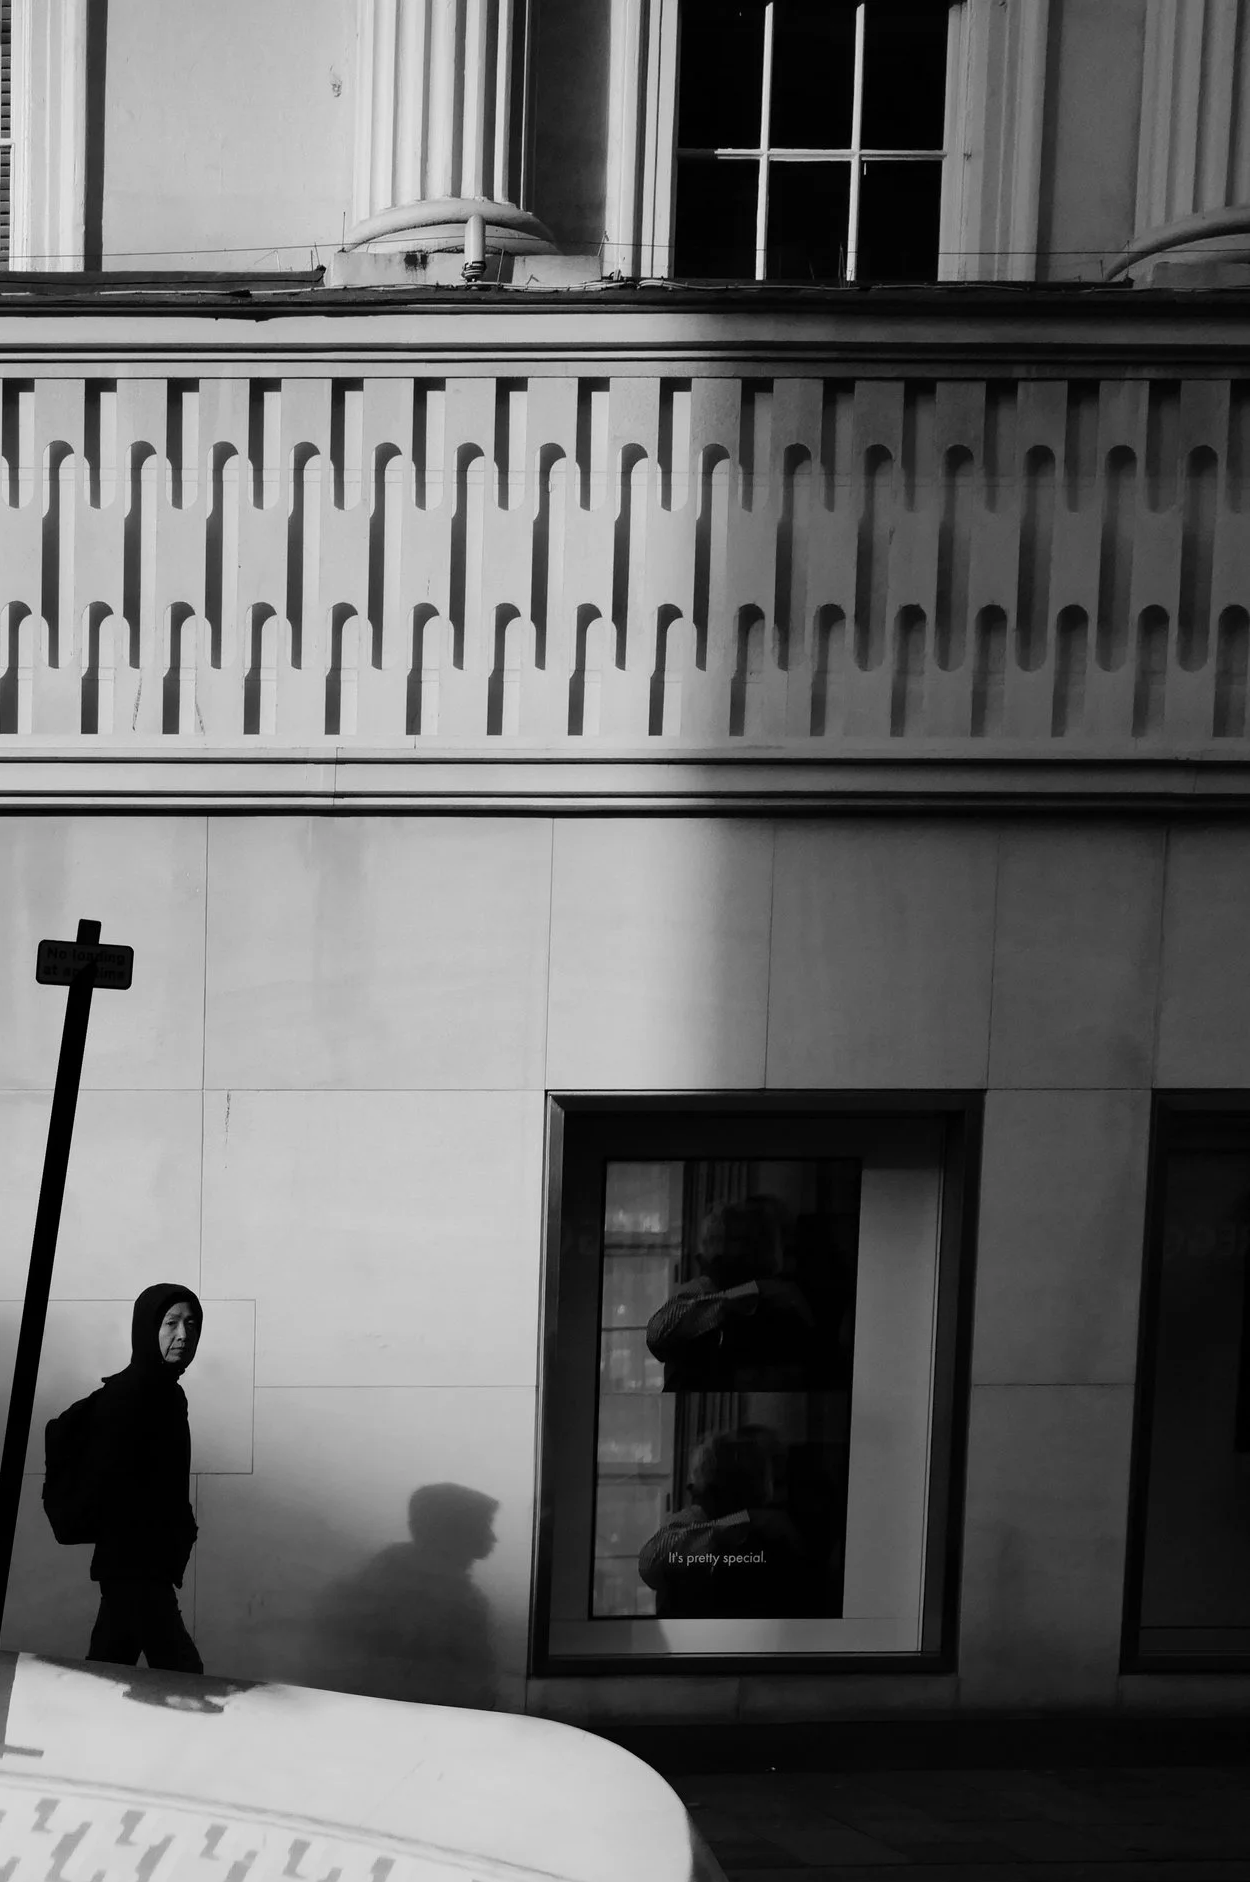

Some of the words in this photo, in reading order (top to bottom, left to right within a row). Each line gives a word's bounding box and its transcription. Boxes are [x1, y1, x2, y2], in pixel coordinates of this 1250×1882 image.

[47, 947, 67, 961] No
[72, 949, 126, 966] loading
[44, 964, 58, 975] at
[668, 1552, 683, 1563] It's
[686, 1553, 720, 1566] pretty
[722, 1550, 766, 1566] special.
